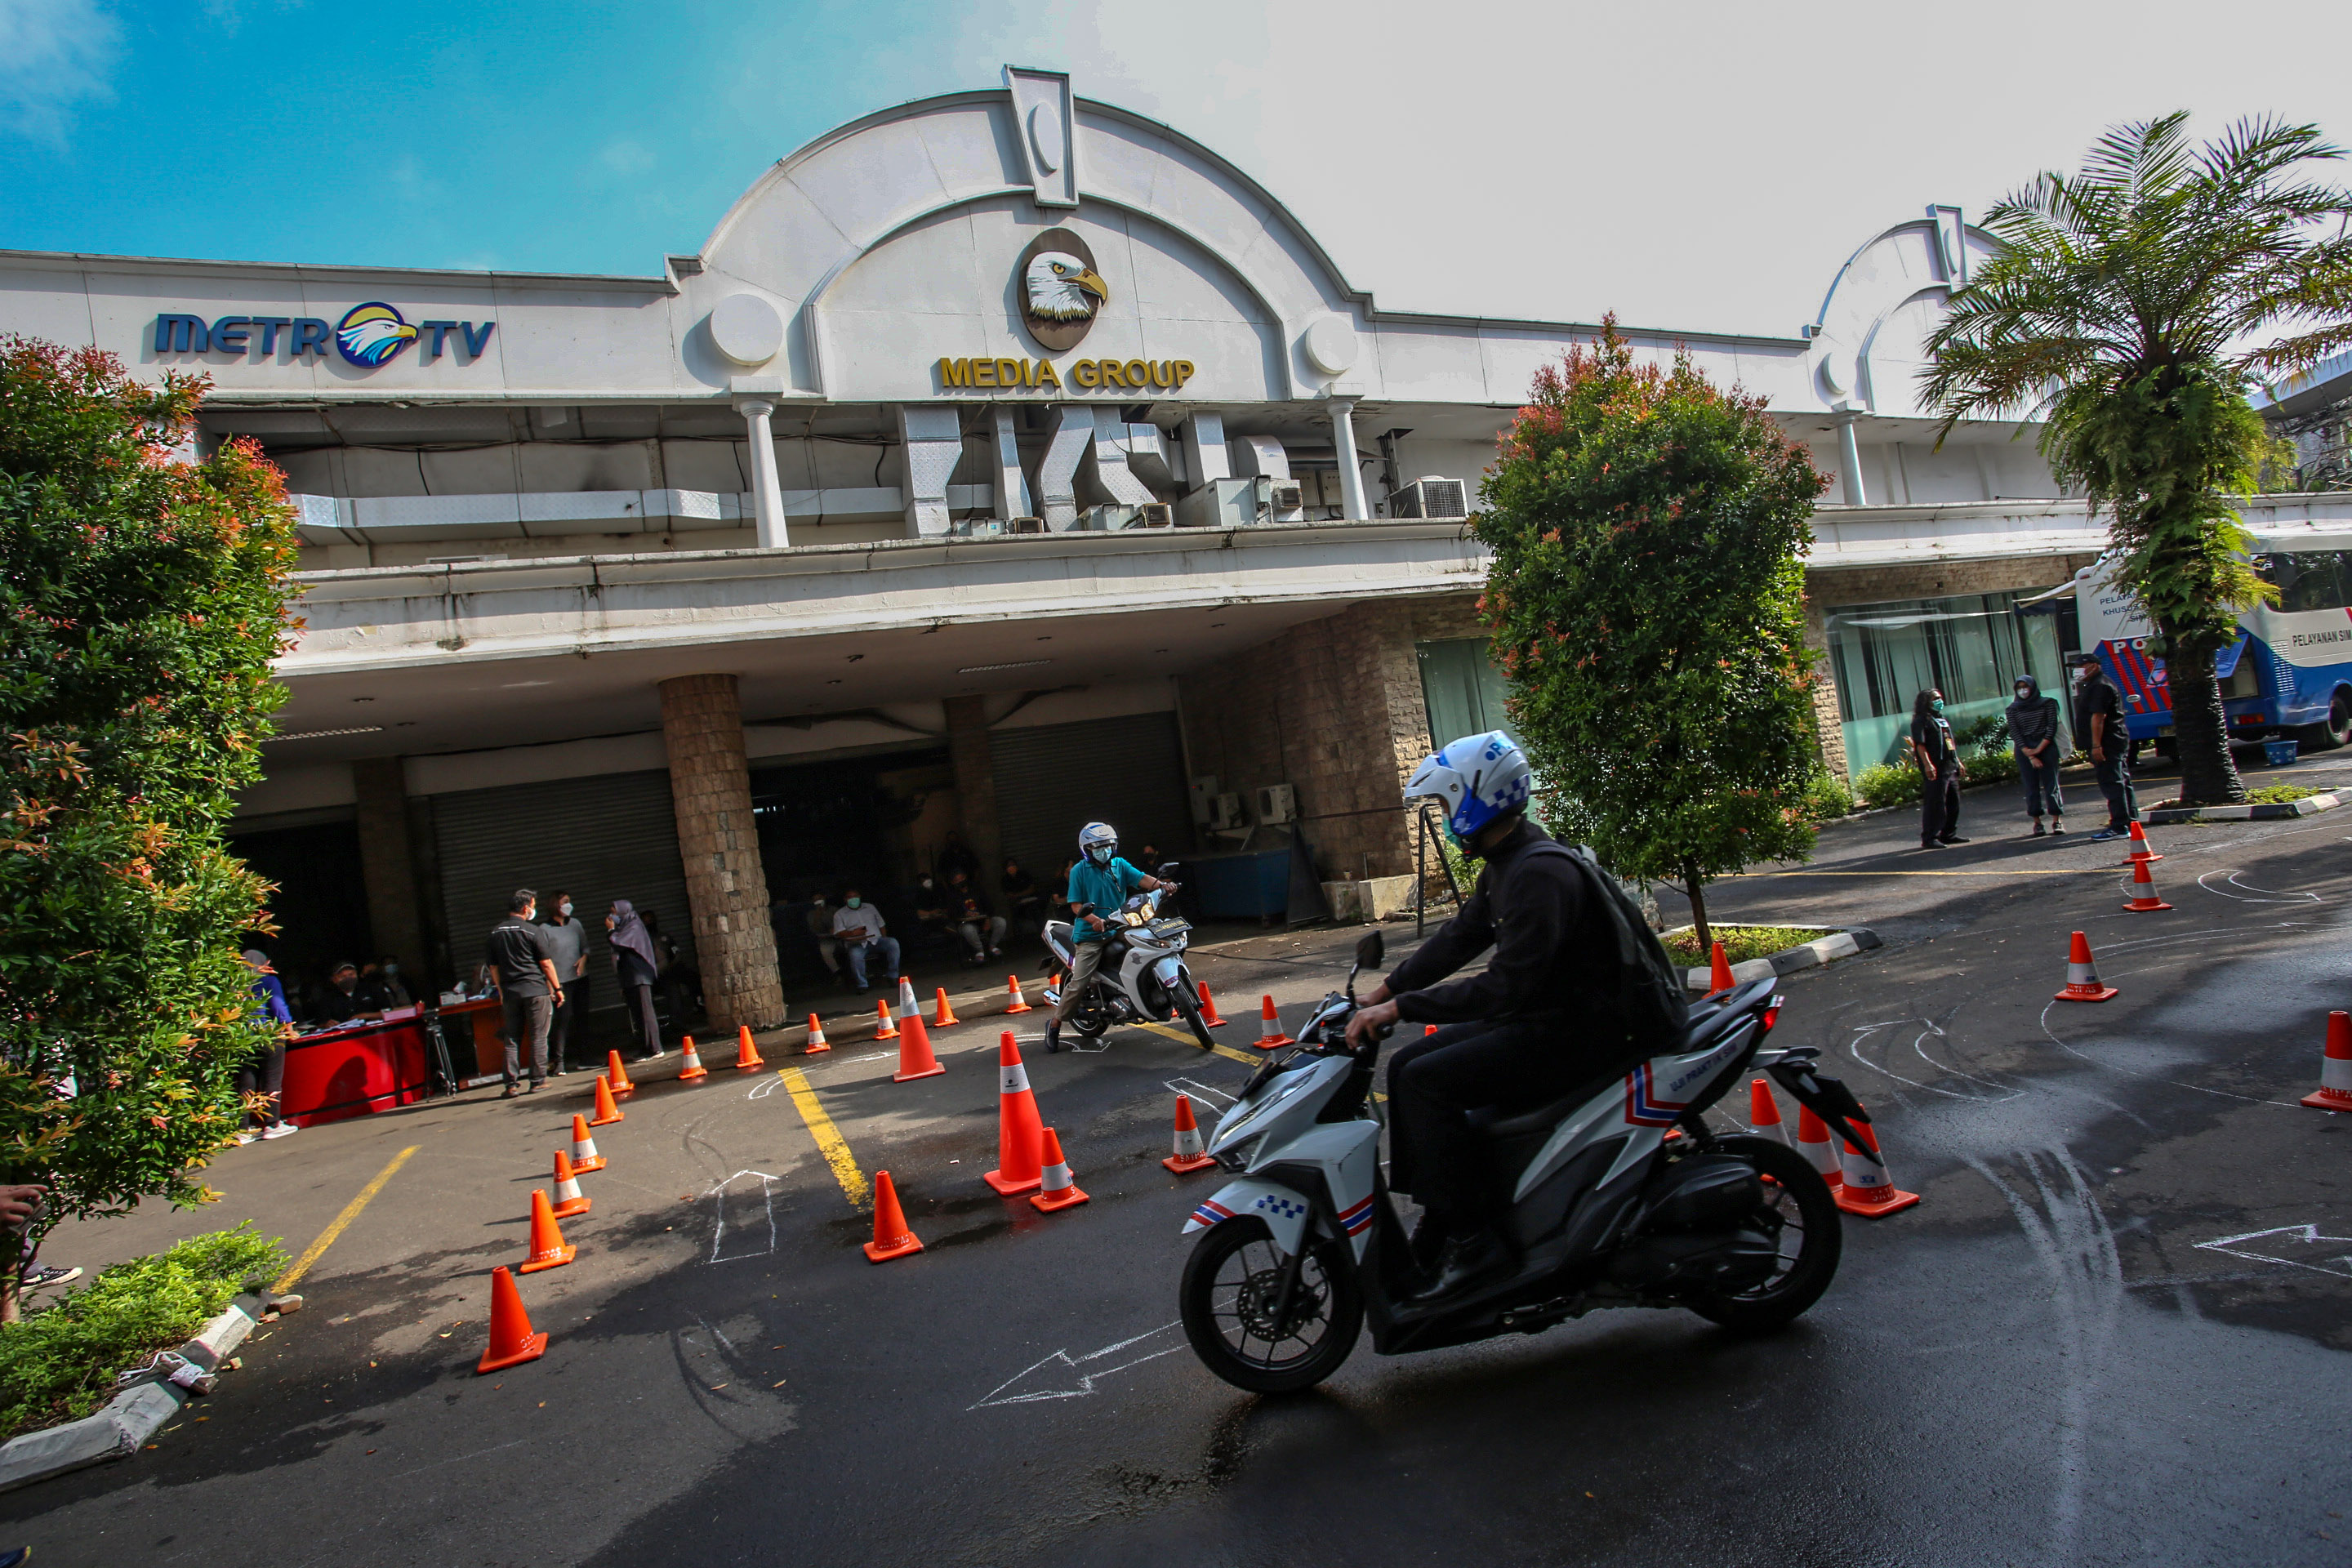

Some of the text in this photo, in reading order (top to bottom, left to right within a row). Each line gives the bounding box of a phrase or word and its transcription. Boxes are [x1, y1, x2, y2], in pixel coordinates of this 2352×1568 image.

[423, 320, 497, 357] TV
[939, 357, 1195, 388] MEDIA GROUP
[2100, 593, 2138, 605] PELAYAN
[2292, 630, 2338, 647] PELAYANAN
